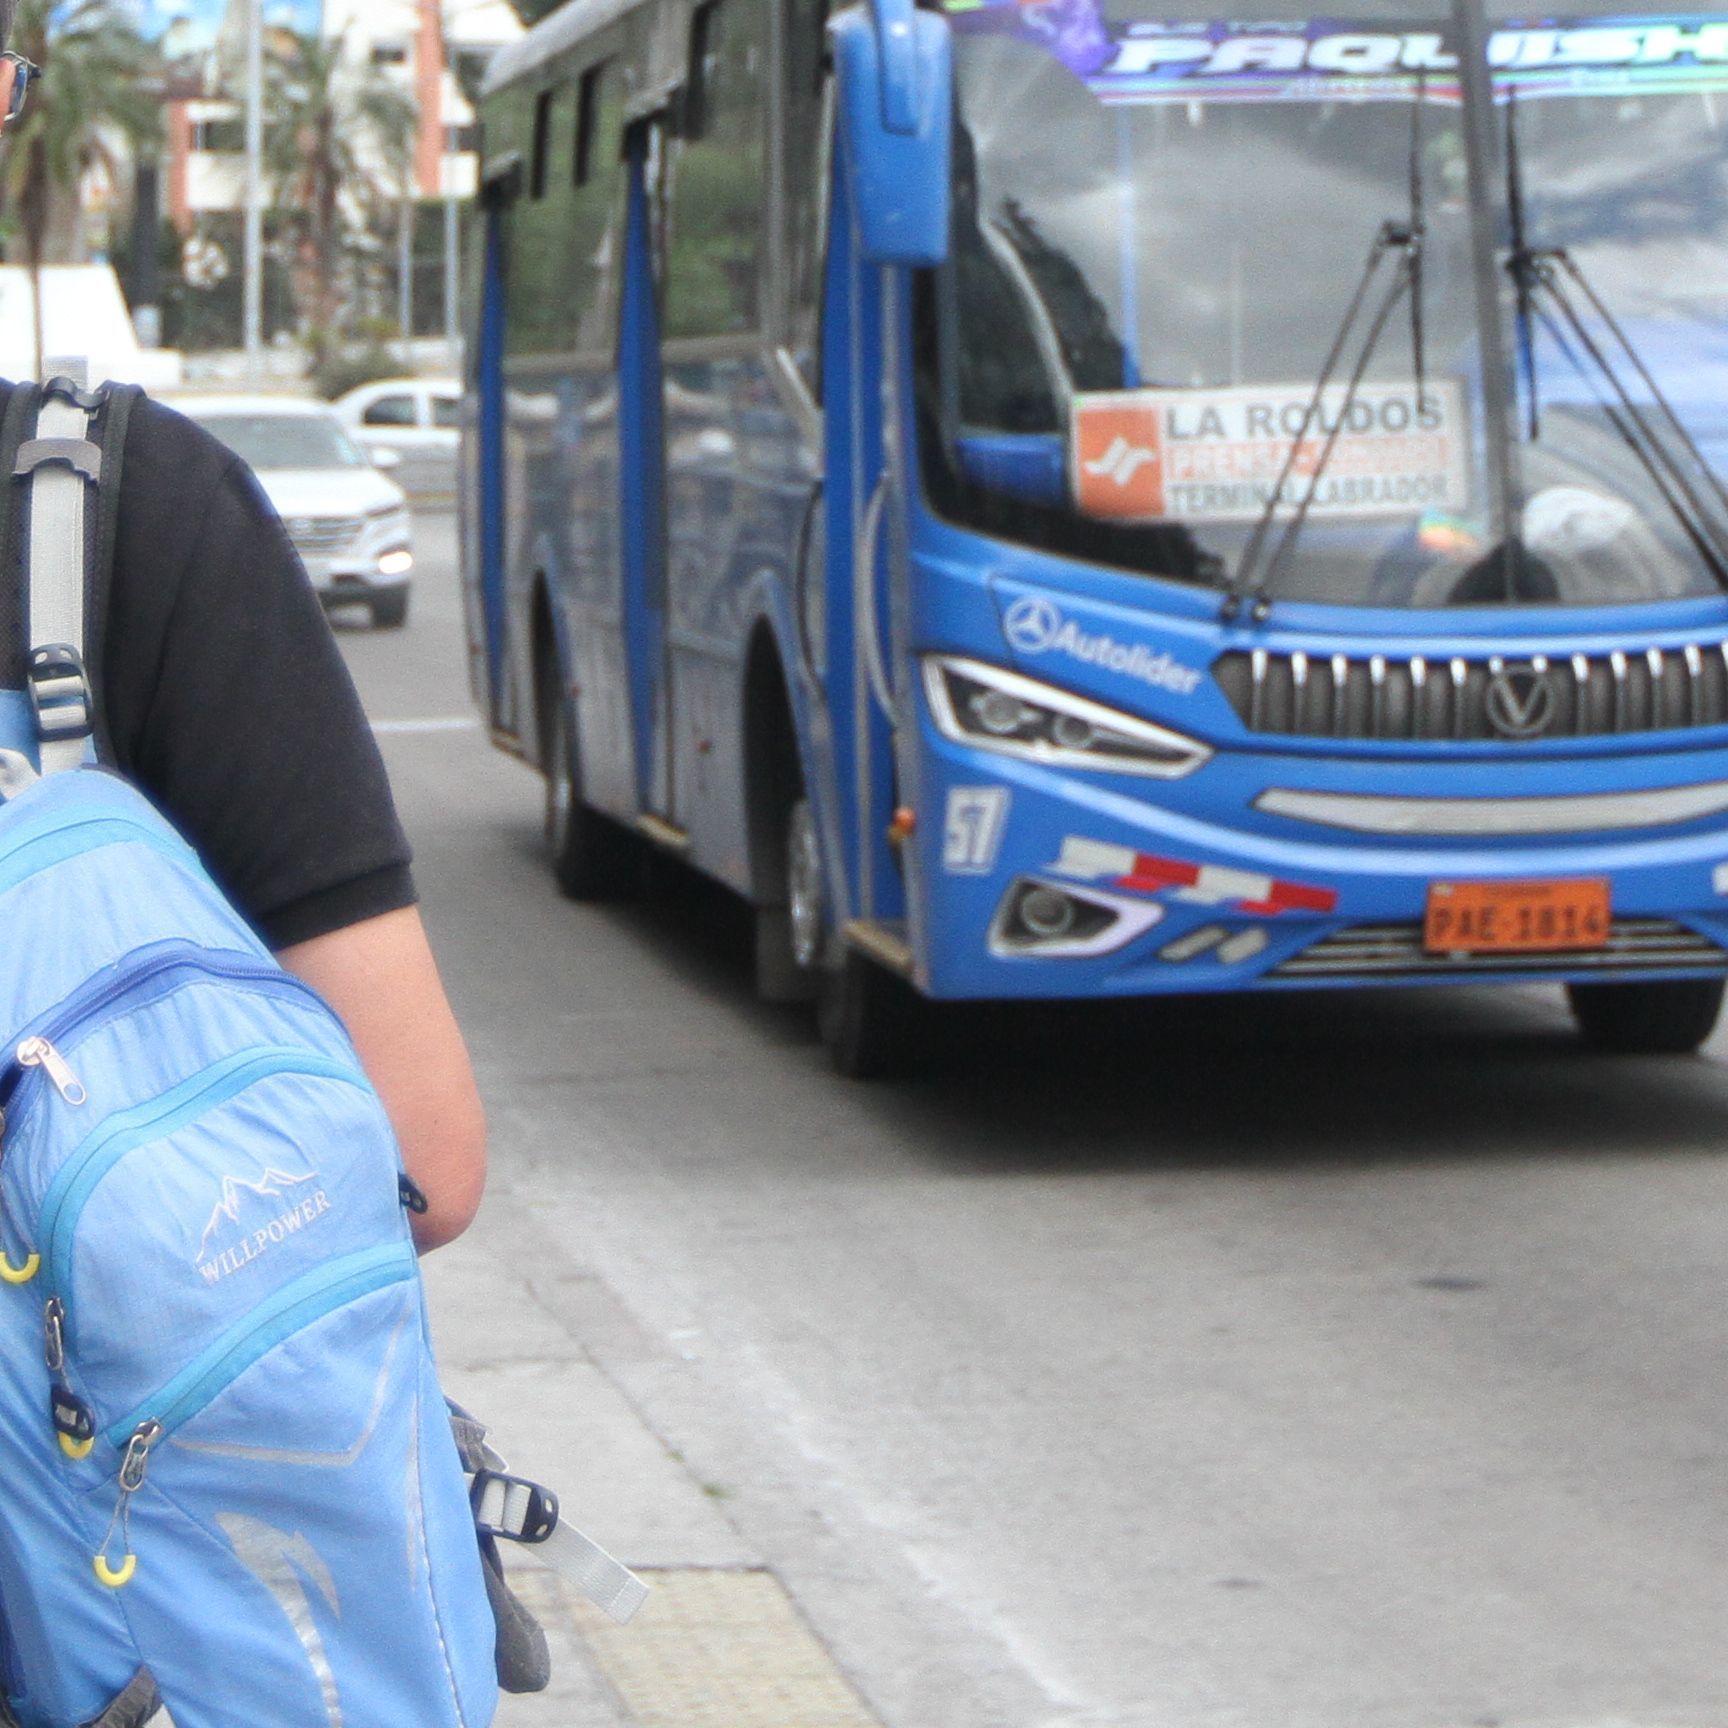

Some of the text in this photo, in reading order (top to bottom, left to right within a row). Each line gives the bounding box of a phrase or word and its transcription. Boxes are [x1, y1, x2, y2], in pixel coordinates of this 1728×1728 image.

[1165, 396, 1443, 440] LA ROLDOS
[1052, 622, 1202, 694] Autolider
[945, 786, 1005, 872] 57
[198, 1190, 332, 1286] WILLPOWER
